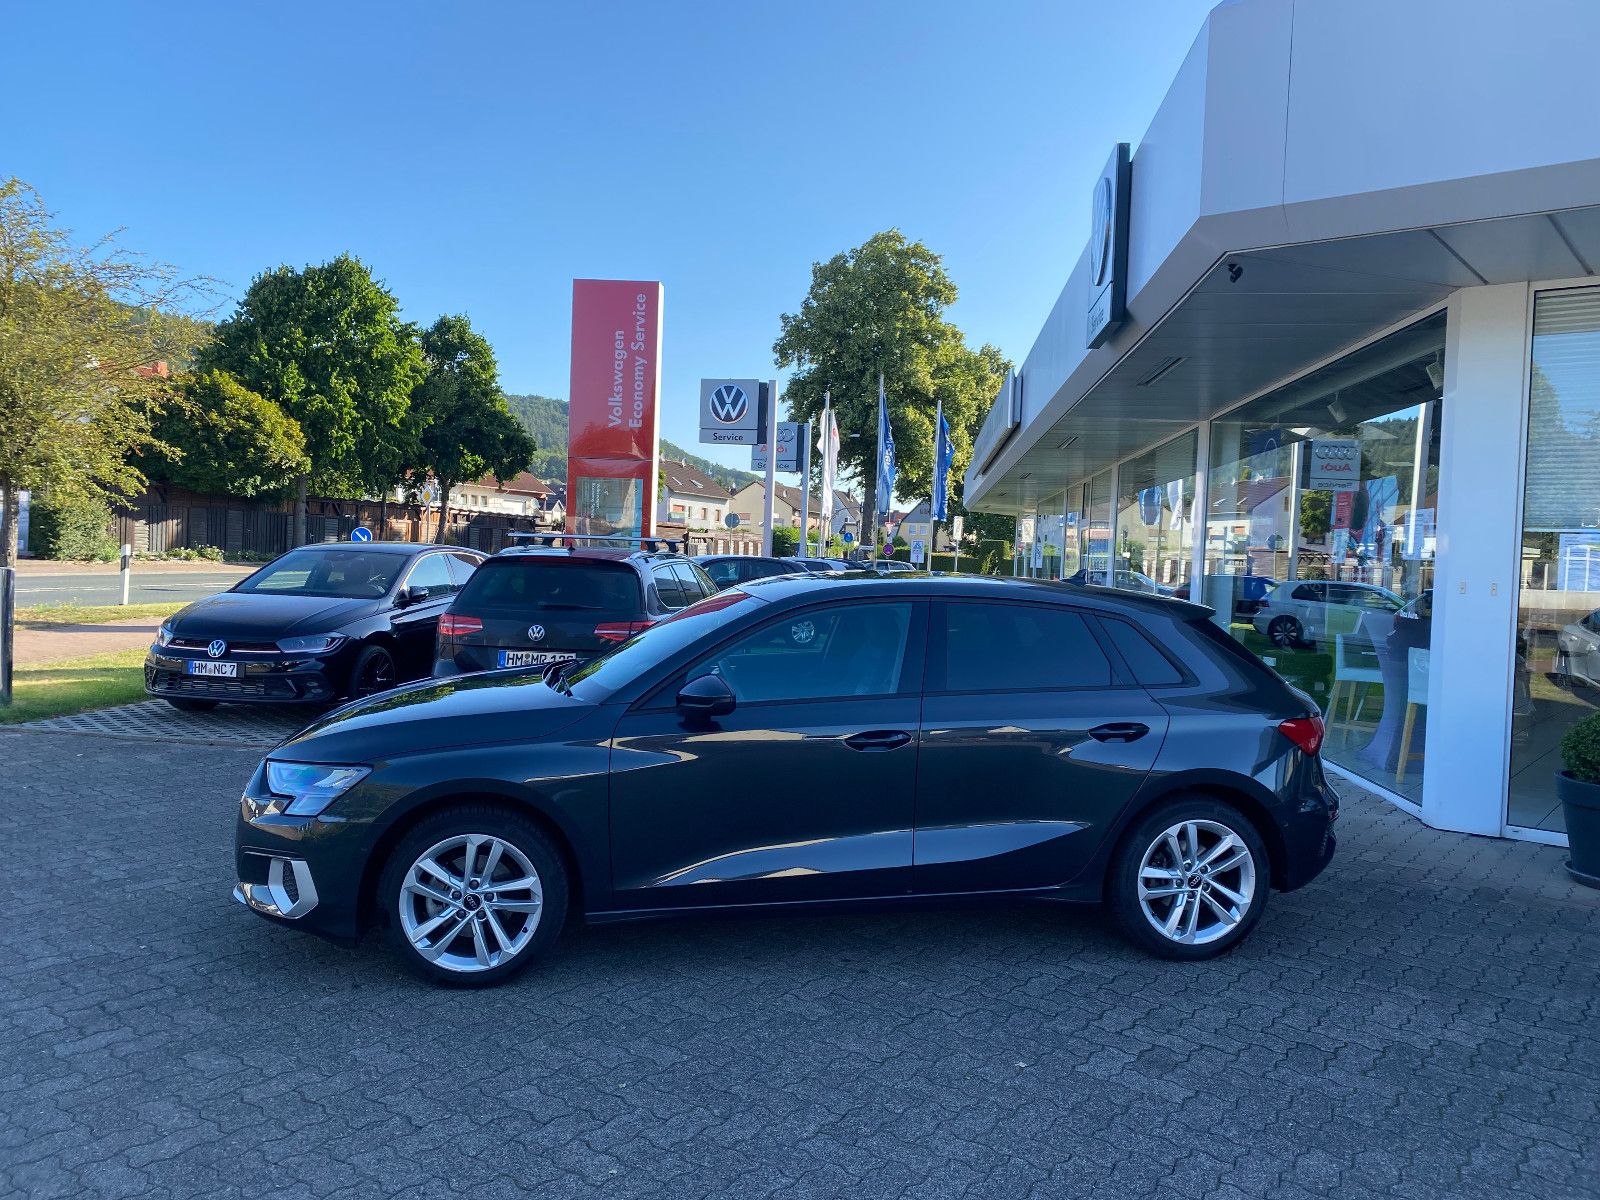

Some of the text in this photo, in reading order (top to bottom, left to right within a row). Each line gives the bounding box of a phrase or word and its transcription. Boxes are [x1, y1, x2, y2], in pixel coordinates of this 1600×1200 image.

[629, 293, 648, 429] Economy Service
[608, 330, 627, 428] Volkswagen
[712, 432, 744, 441] Service
[760, 444, 788, 453] Adi
[757, 461, 790, 469] Seice
[506, 652, 524, 666] HM
[193, 662, 236, 675] HM NC 7
